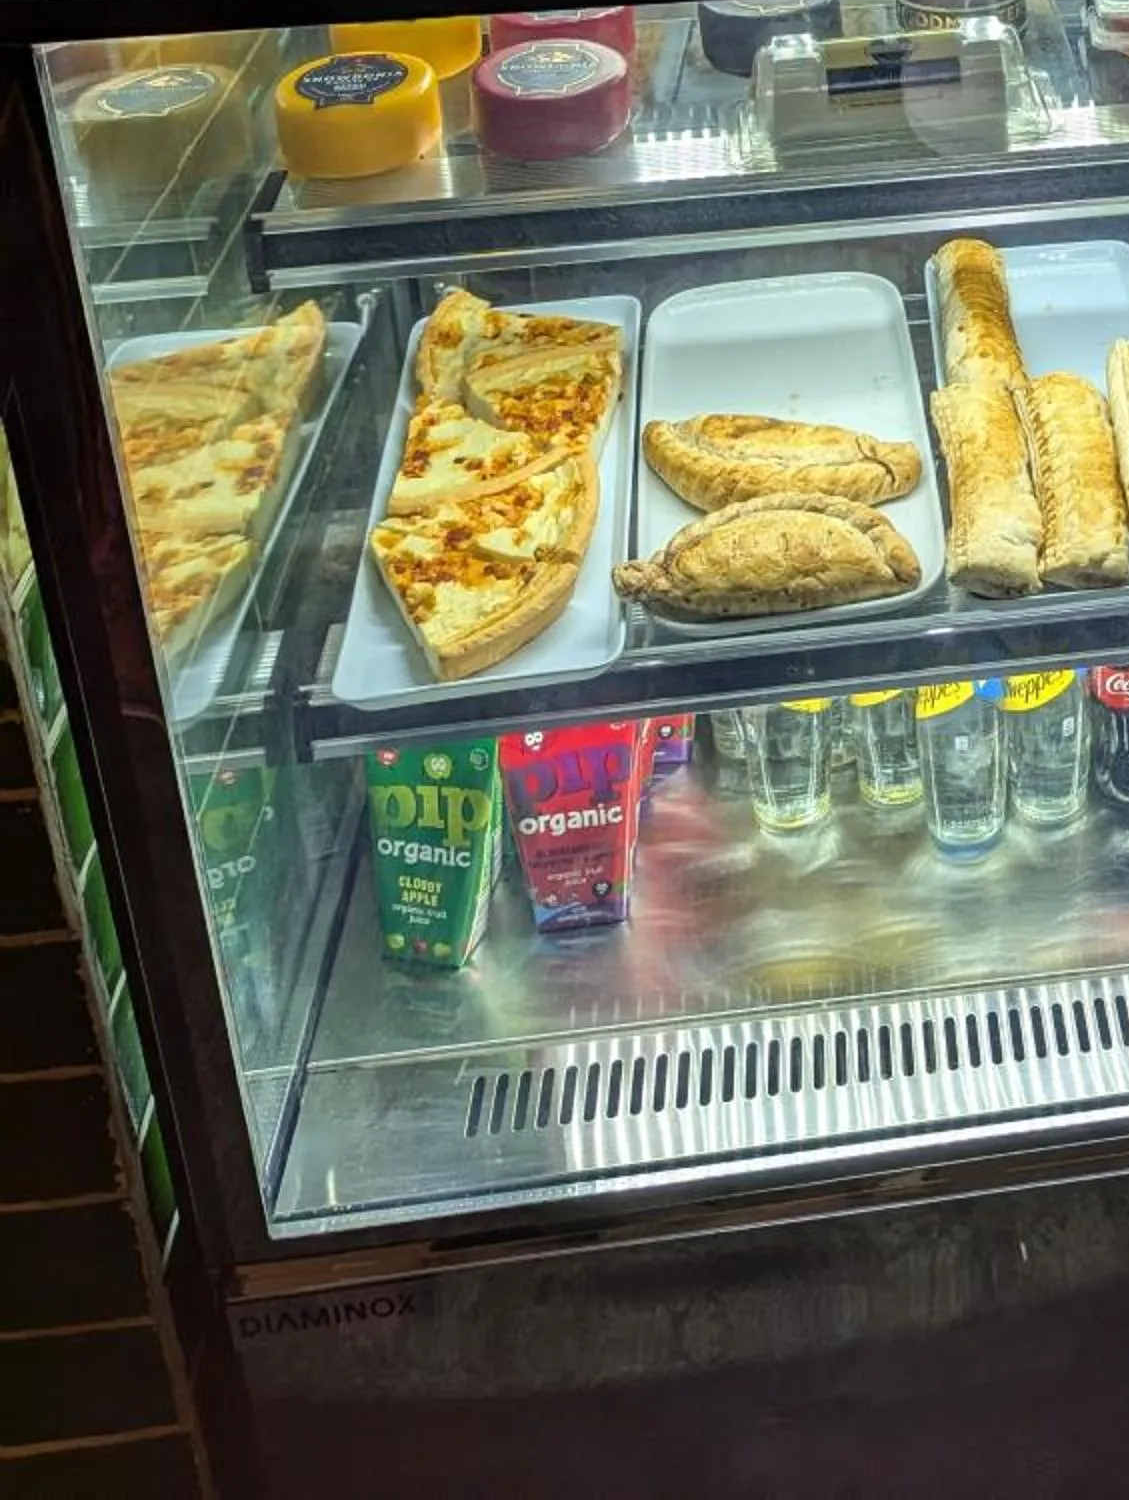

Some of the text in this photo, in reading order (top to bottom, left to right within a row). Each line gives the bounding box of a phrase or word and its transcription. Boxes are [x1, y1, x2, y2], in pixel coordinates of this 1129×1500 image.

[511, 742, 631, 812] pip
[370, 784, 491, 848] pip
[518, 803, 623, 835] organic
[377, 838, 471, 868] organic
[238, 1293, 417, 1339] DIAMINOX
